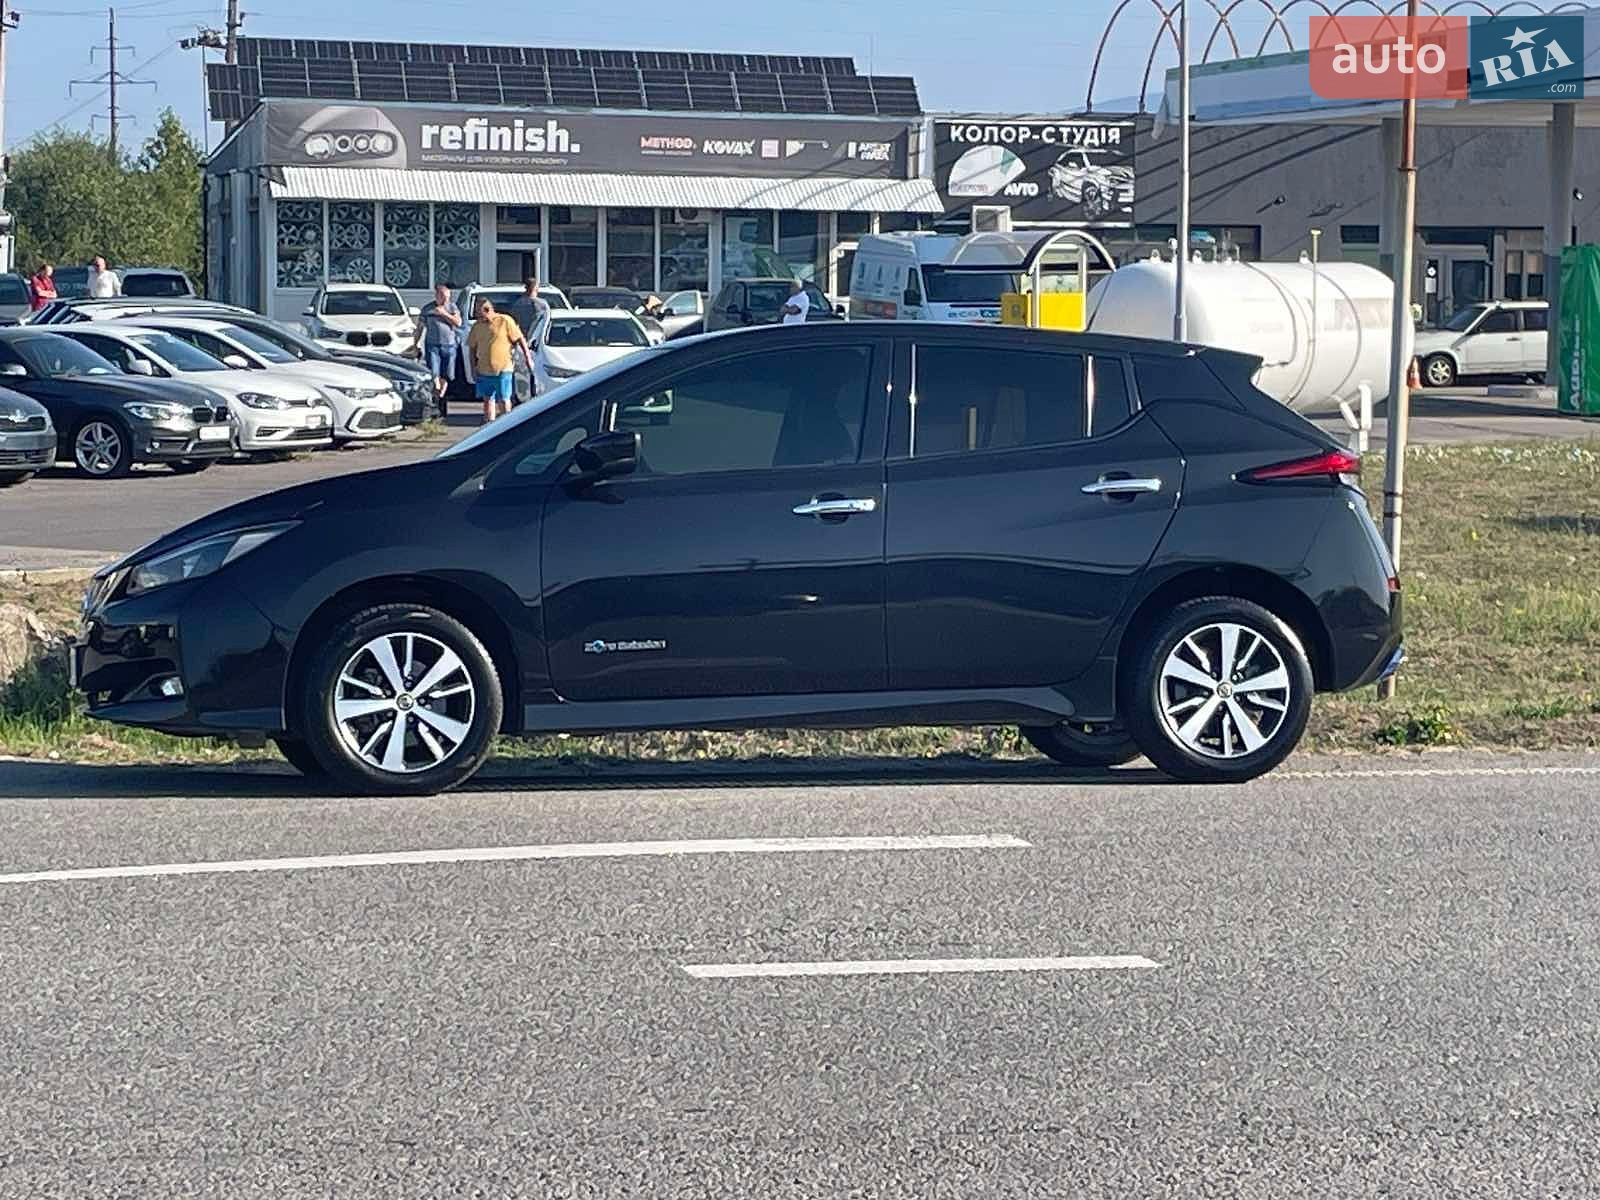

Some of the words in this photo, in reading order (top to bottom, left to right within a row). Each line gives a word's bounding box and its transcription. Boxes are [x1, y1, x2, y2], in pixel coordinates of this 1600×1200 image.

[421, 118, 580, 153] refinish.
[702, 139, 756, 154] KOVAX
[950, 125, 1121, 147] КОЛОР-СТУДІЯ
